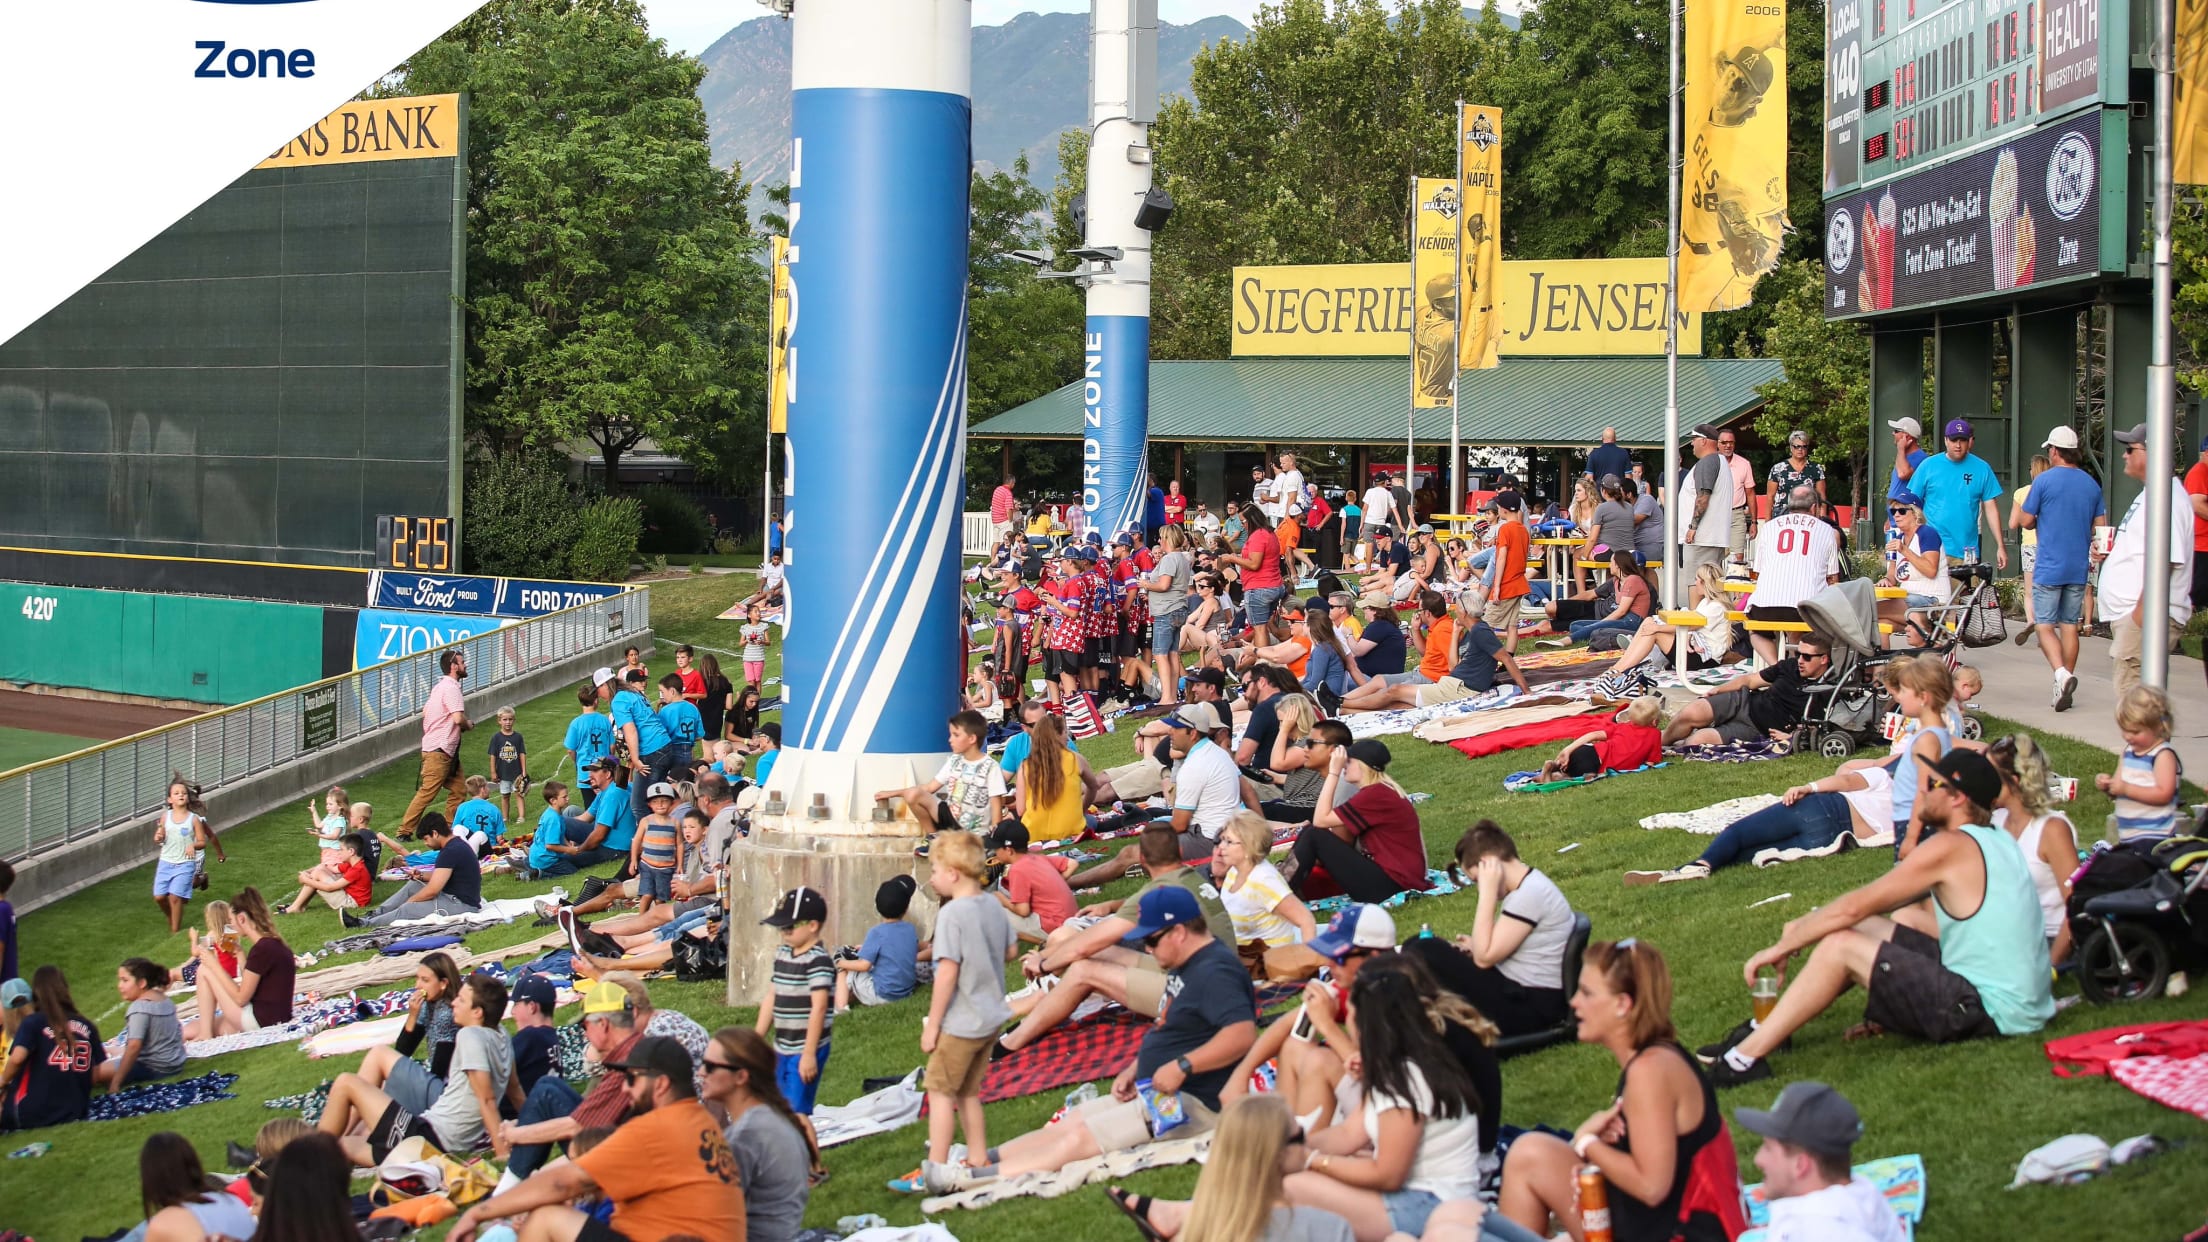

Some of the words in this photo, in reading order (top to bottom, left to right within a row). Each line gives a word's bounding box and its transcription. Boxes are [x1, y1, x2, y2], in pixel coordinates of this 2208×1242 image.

[1745, 5, 1781, 17] 2006
[1832, 4, 1860, 41] LOCAL
[2046, 0, 2098, 60] HEALTH
[1832, 41, 1859, 104] 140
[2045, 64, 2074, 92] UNIVERSITY
[2075, 61, 2082, 80] OF
[2082, 55, 2098, 78] UTAH
[1991, 80, 1999, 123] 6
[341, 105, 441, 154] BANK
[2054, 146, 2084, 205] Ford
[1423, 202, 1446, 210] WALK
[1691, 179, 1719, 212] 36
[1902, 207, 1916, 239] $25
[1917, 188, 1981, 232] All-You-Can-Eat
[1419, 236, 1457, 250] KENDR
[1905, 246, 1923, 276] Ford
[1924, 244, 1945, 272] Zone
[1946, 232, 1976, 267] Ticket!
[2057, 235, 2079, 267] Zone
[1237, 277, 1412, 335] SIEGFRIE
[1520, 272, 1691, 341] JENSEN
[1833, 285, 1846, 309] Zone
[1085, 332, 1102, 428] ZONE
[1082, 438, 1101, 534] FORD
[1776, 513, 1816, 529] EAGER
[393, 517, 448, 570] 2:25
[1776, 528, 1811, 556] 01
[22, 595, 58, 621] 420'
[396, 586, 412, 596] BUILT
[413, 577, 457, 609] Ford
[457, 590, 478, 601] PROUD
[521, 589, 562, 611] FORD
[563, 592, 604, 611] ZONE
[377, 623, 472, 660] ZIONS
[380, 670, 432, 710] BAN
[47, 1039, 92, 1073] 48
